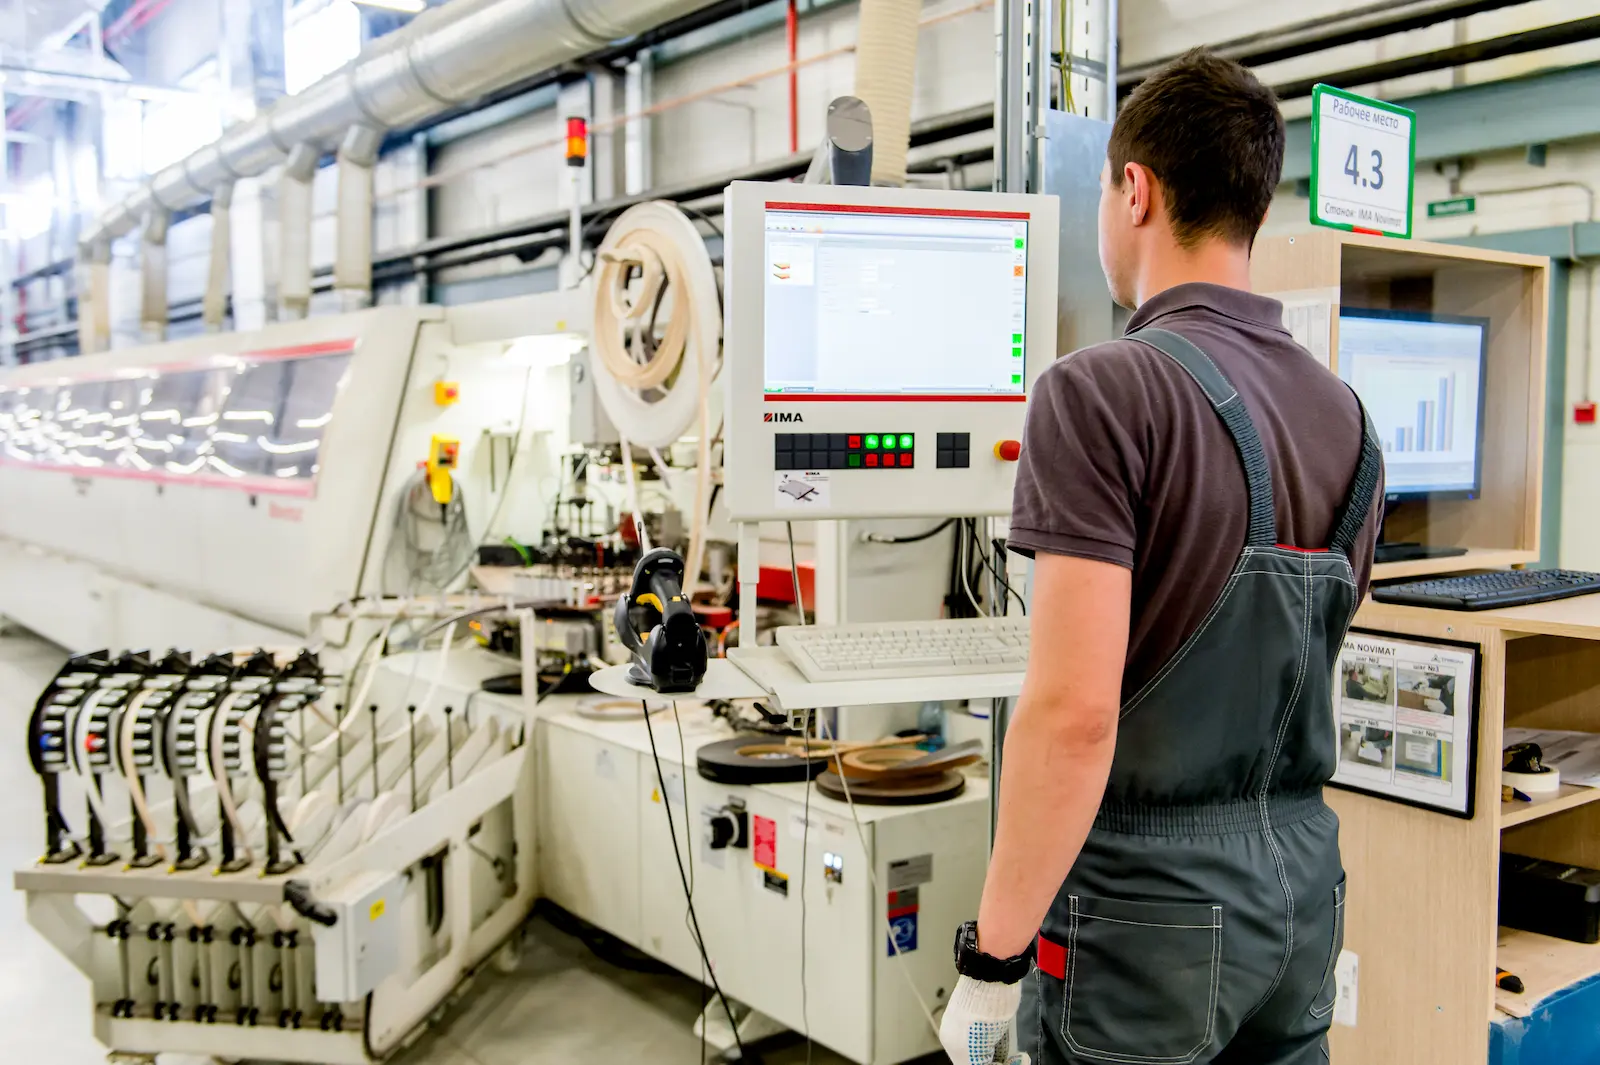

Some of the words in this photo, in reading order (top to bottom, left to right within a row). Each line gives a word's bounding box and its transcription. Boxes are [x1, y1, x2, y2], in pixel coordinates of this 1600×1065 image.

[1333, 98, 1371, 122] Рабочее
[1373, 112, 1399, 129] место
[1344, 144, 1384, 190] 4.3
[1359, 208, 1372, 221] IMA
[774, 412, 804, 423] IMA
[1342, 641, 1355, 651] MA
[1357, 643, 1396, 656] NOVIMAT
